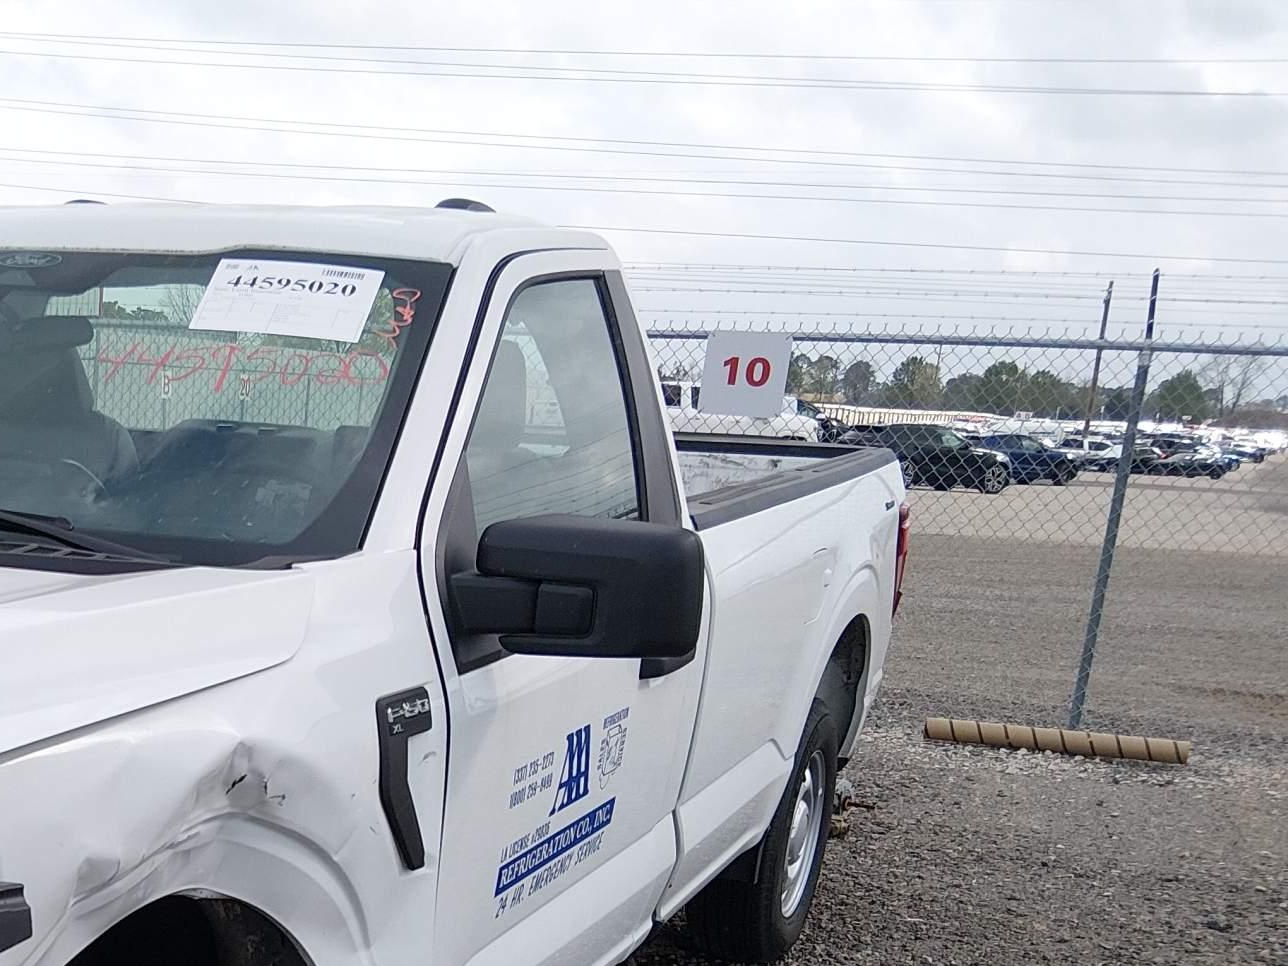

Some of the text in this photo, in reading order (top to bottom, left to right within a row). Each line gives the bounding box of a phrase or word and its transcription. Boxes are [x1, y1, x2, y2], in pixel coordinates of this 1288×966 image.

[227, 275, 357, 297] 44595020
[723, 356, 771, 387] 10
[392, 724, 404, 734] XL
[499, 824, 576, 888] REFRIGERATION
[593, 804, 611, 828] INC.
[495, 831, 605, 919] 24 HR. EMERGENCY SERVICE
